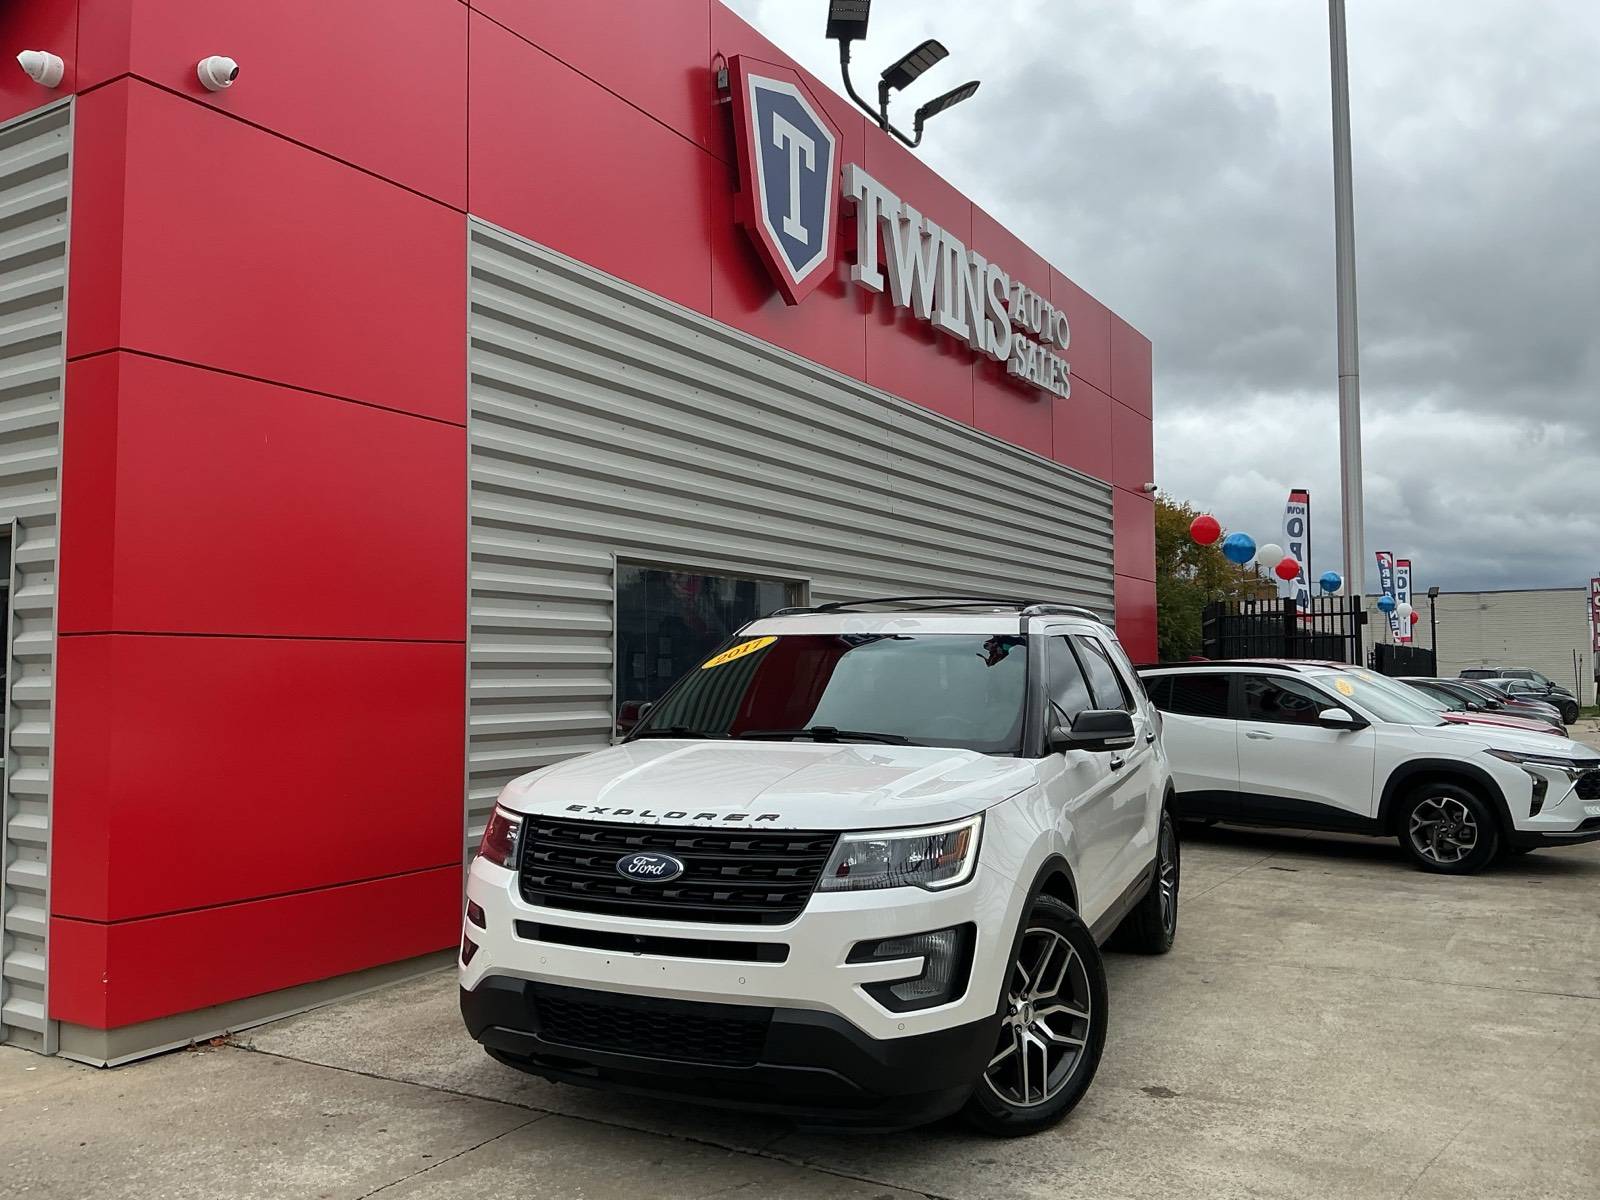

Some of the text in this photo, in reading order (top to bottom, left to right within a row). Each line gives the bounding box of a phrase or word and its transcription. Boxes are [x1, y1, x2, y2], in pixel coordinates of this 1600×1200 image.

[773, 111, 815, 245] T
[842, 163, 1011, 361] TWINS
[1009, 281, 1070, 350] AUTO
[1008, 333, 1071, 399] SALES
[717, 640, 762, 663] 2017
[565, 804, 781, 822] EXPLORER
[628, 856, 666, 876] Ford
